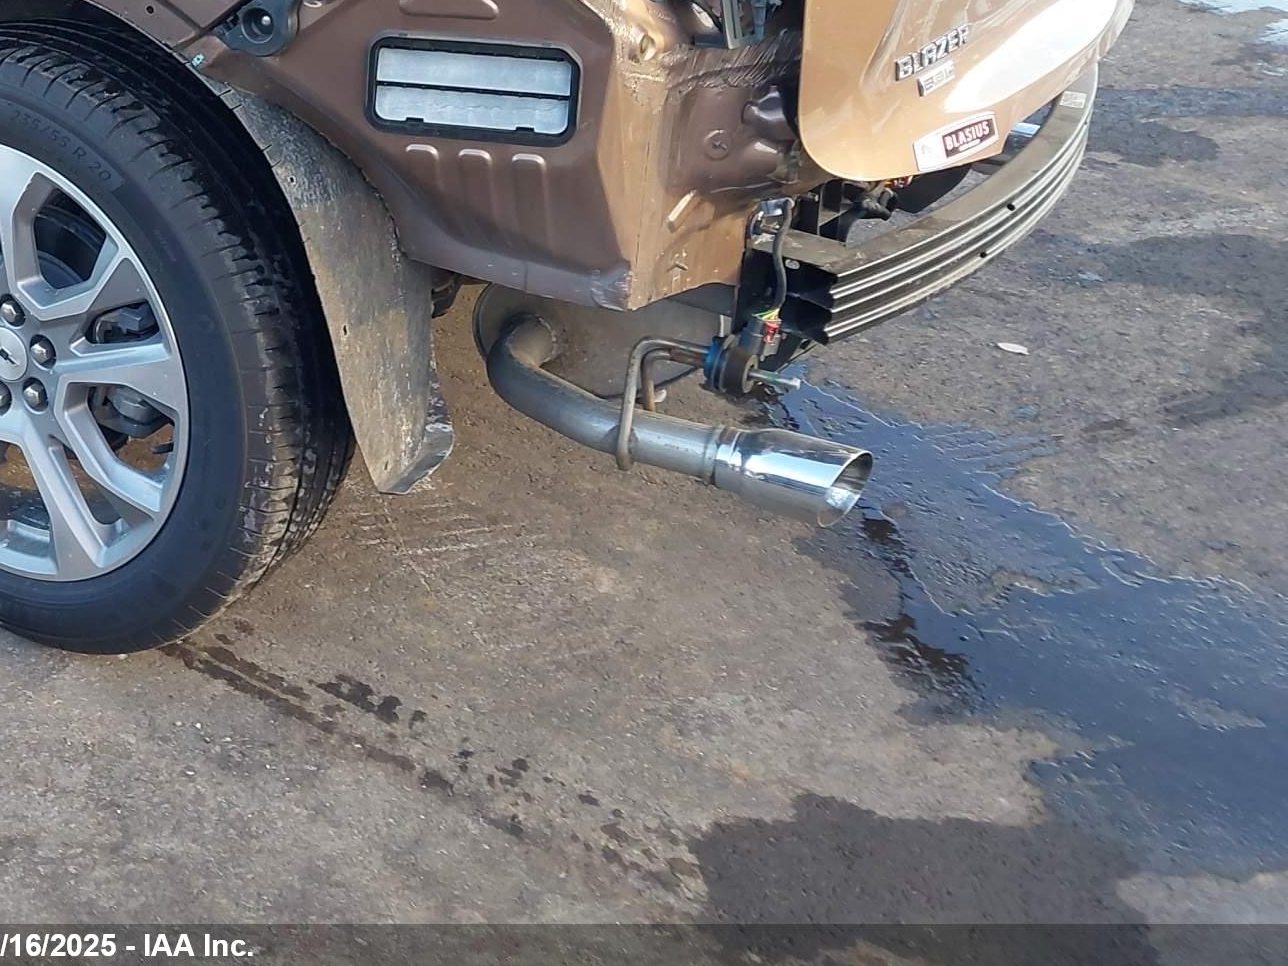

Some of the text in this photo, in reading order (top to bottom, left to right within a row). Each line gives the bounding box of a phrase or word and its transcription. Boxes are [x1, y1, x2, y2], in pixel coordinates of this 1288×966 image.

[895, 24, 969, 81] BLAZER
[944, 120, 990, 151] BLASIUS
[72, 145, 87, 160] R
[88, 161, 113, 182] 20
